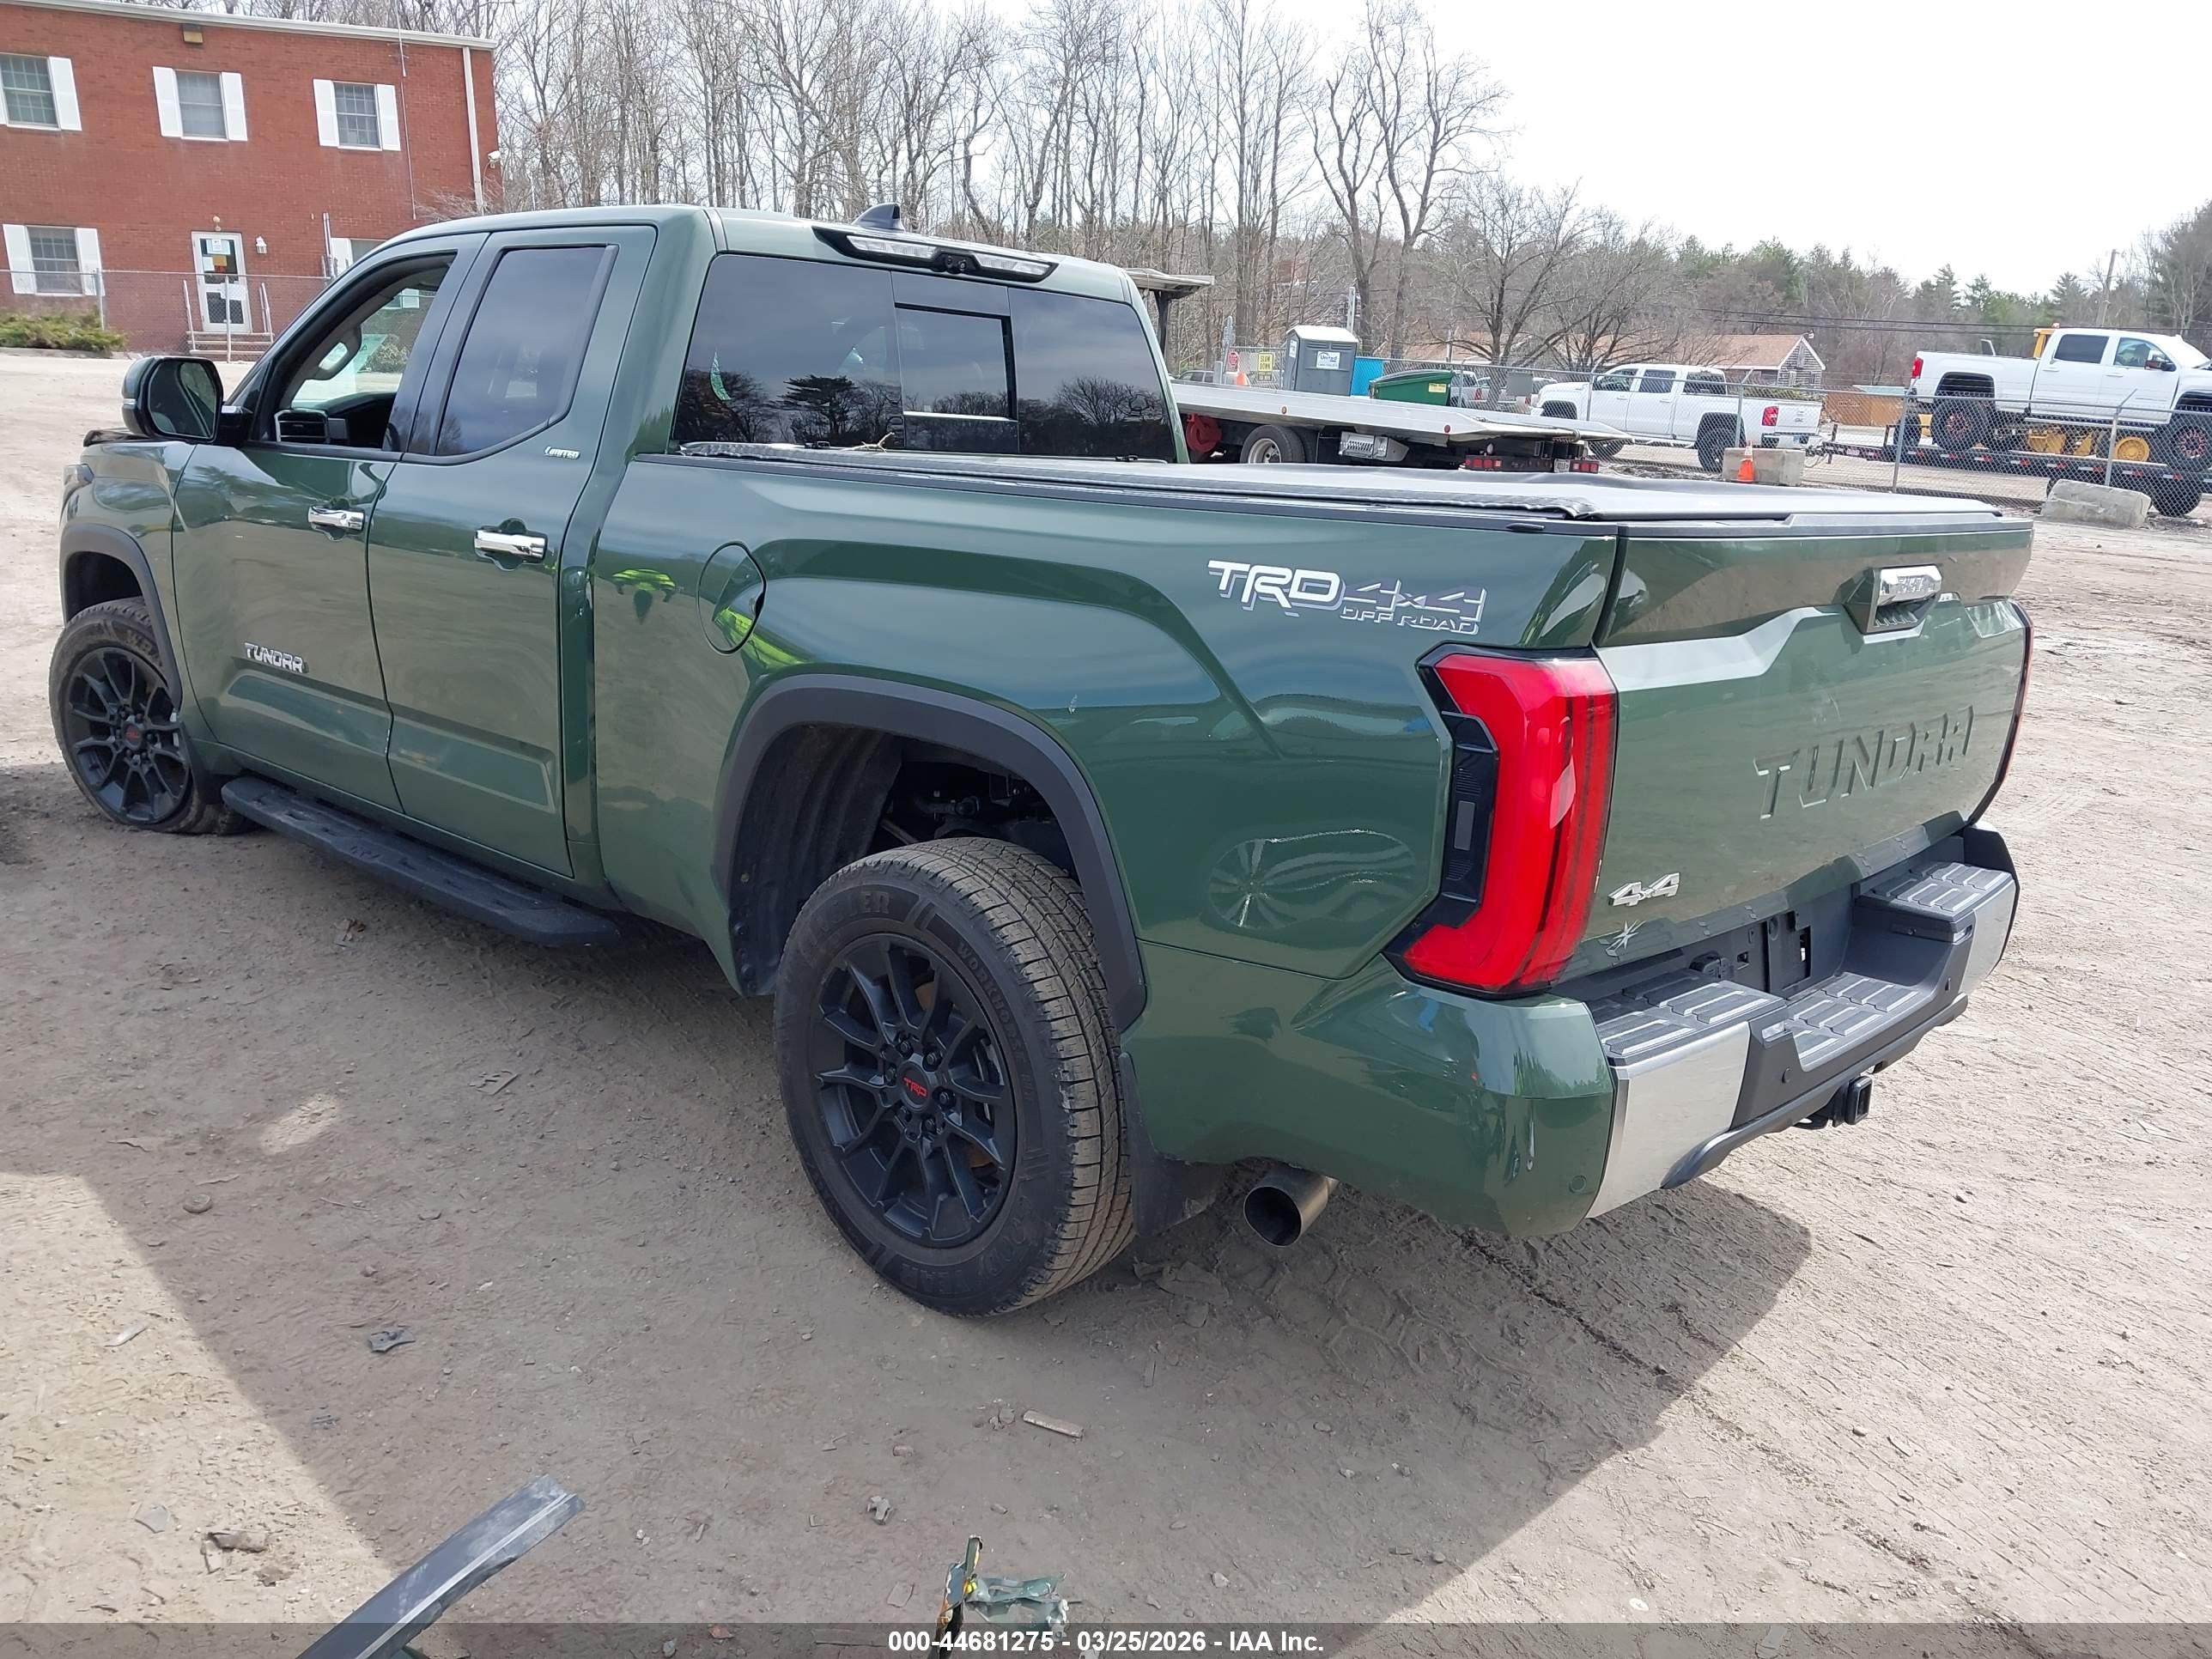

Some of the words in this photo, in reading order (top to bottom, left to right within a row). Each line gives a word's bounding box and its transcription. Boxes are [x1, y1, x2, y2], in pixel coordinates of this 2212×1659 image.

[1208, 560, 1346, 617] TRD
[1340, 606, 1395, 623] OFF
[1396, 615, 1480, 635] ROAD
[245, 642, 303, 673] TUNDRA
[1753, 705, 1973, 819] TUNDRA
[903, 1077, 927, 1097] TRD
